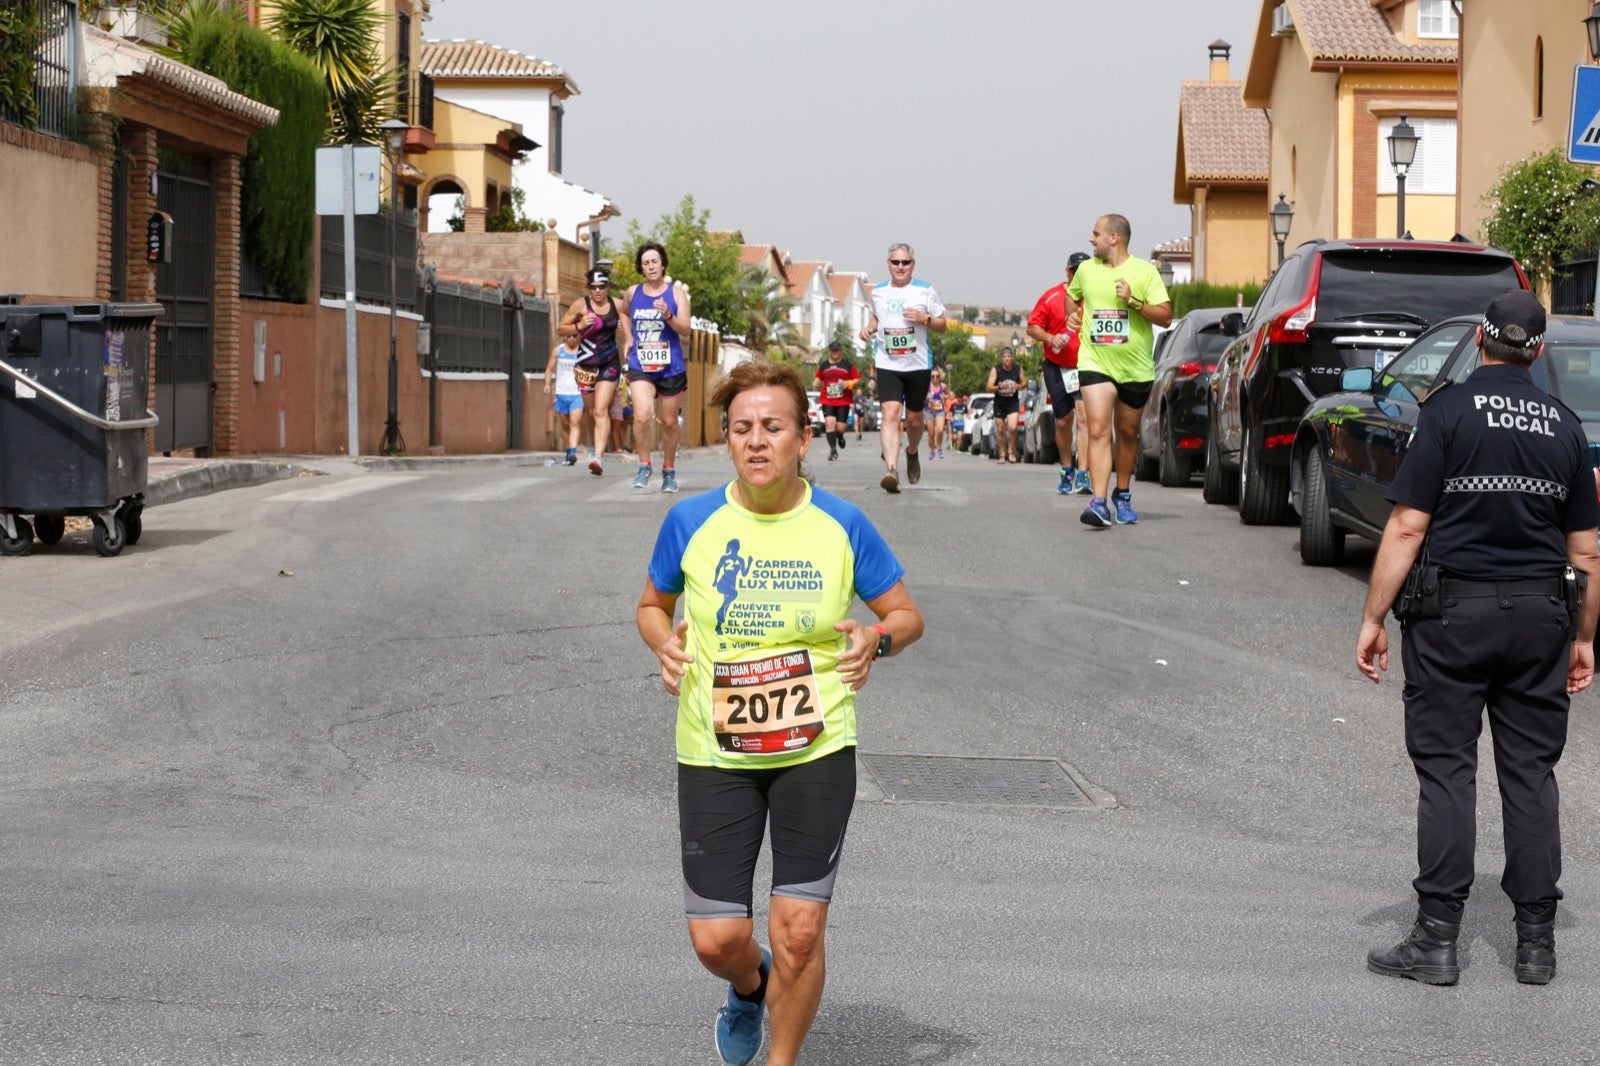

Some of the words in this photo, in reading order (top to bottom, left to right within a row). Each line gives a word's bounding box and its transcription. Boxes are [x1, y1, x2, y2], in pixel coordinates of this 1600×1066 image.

[1096, 320, 1123, 333] 360
[892, 336, 907, 347] 89
[640, 350, 667, 361] 3018
[1473, 394, 1561, 422] POLICIA
[1486, 411, 1555, 437] LOCAL
[755, 559, 813, 569] CARRERA
[752, 570, 822, 579] SOLIDARIA
[739, 579, 767, 589] LUX
[773, 580, 823, 590] MUNDI
[733, 603, 781, 612] MUÉVETE
[728, 611, 771, 619] CONTRA
[728, 619, 740, 627] EL
[742, 618, 785, 628] CÁNCER
[724, 627, 766, 636] JUVENIL
[730, 664, 749, 676] GRAN
[750, 660, 774, 675] PREMIO
[774, 658, 783, 669] DE
[784, 653, 805, 668] FONDO
[726, 684, 815, 725] 2072
